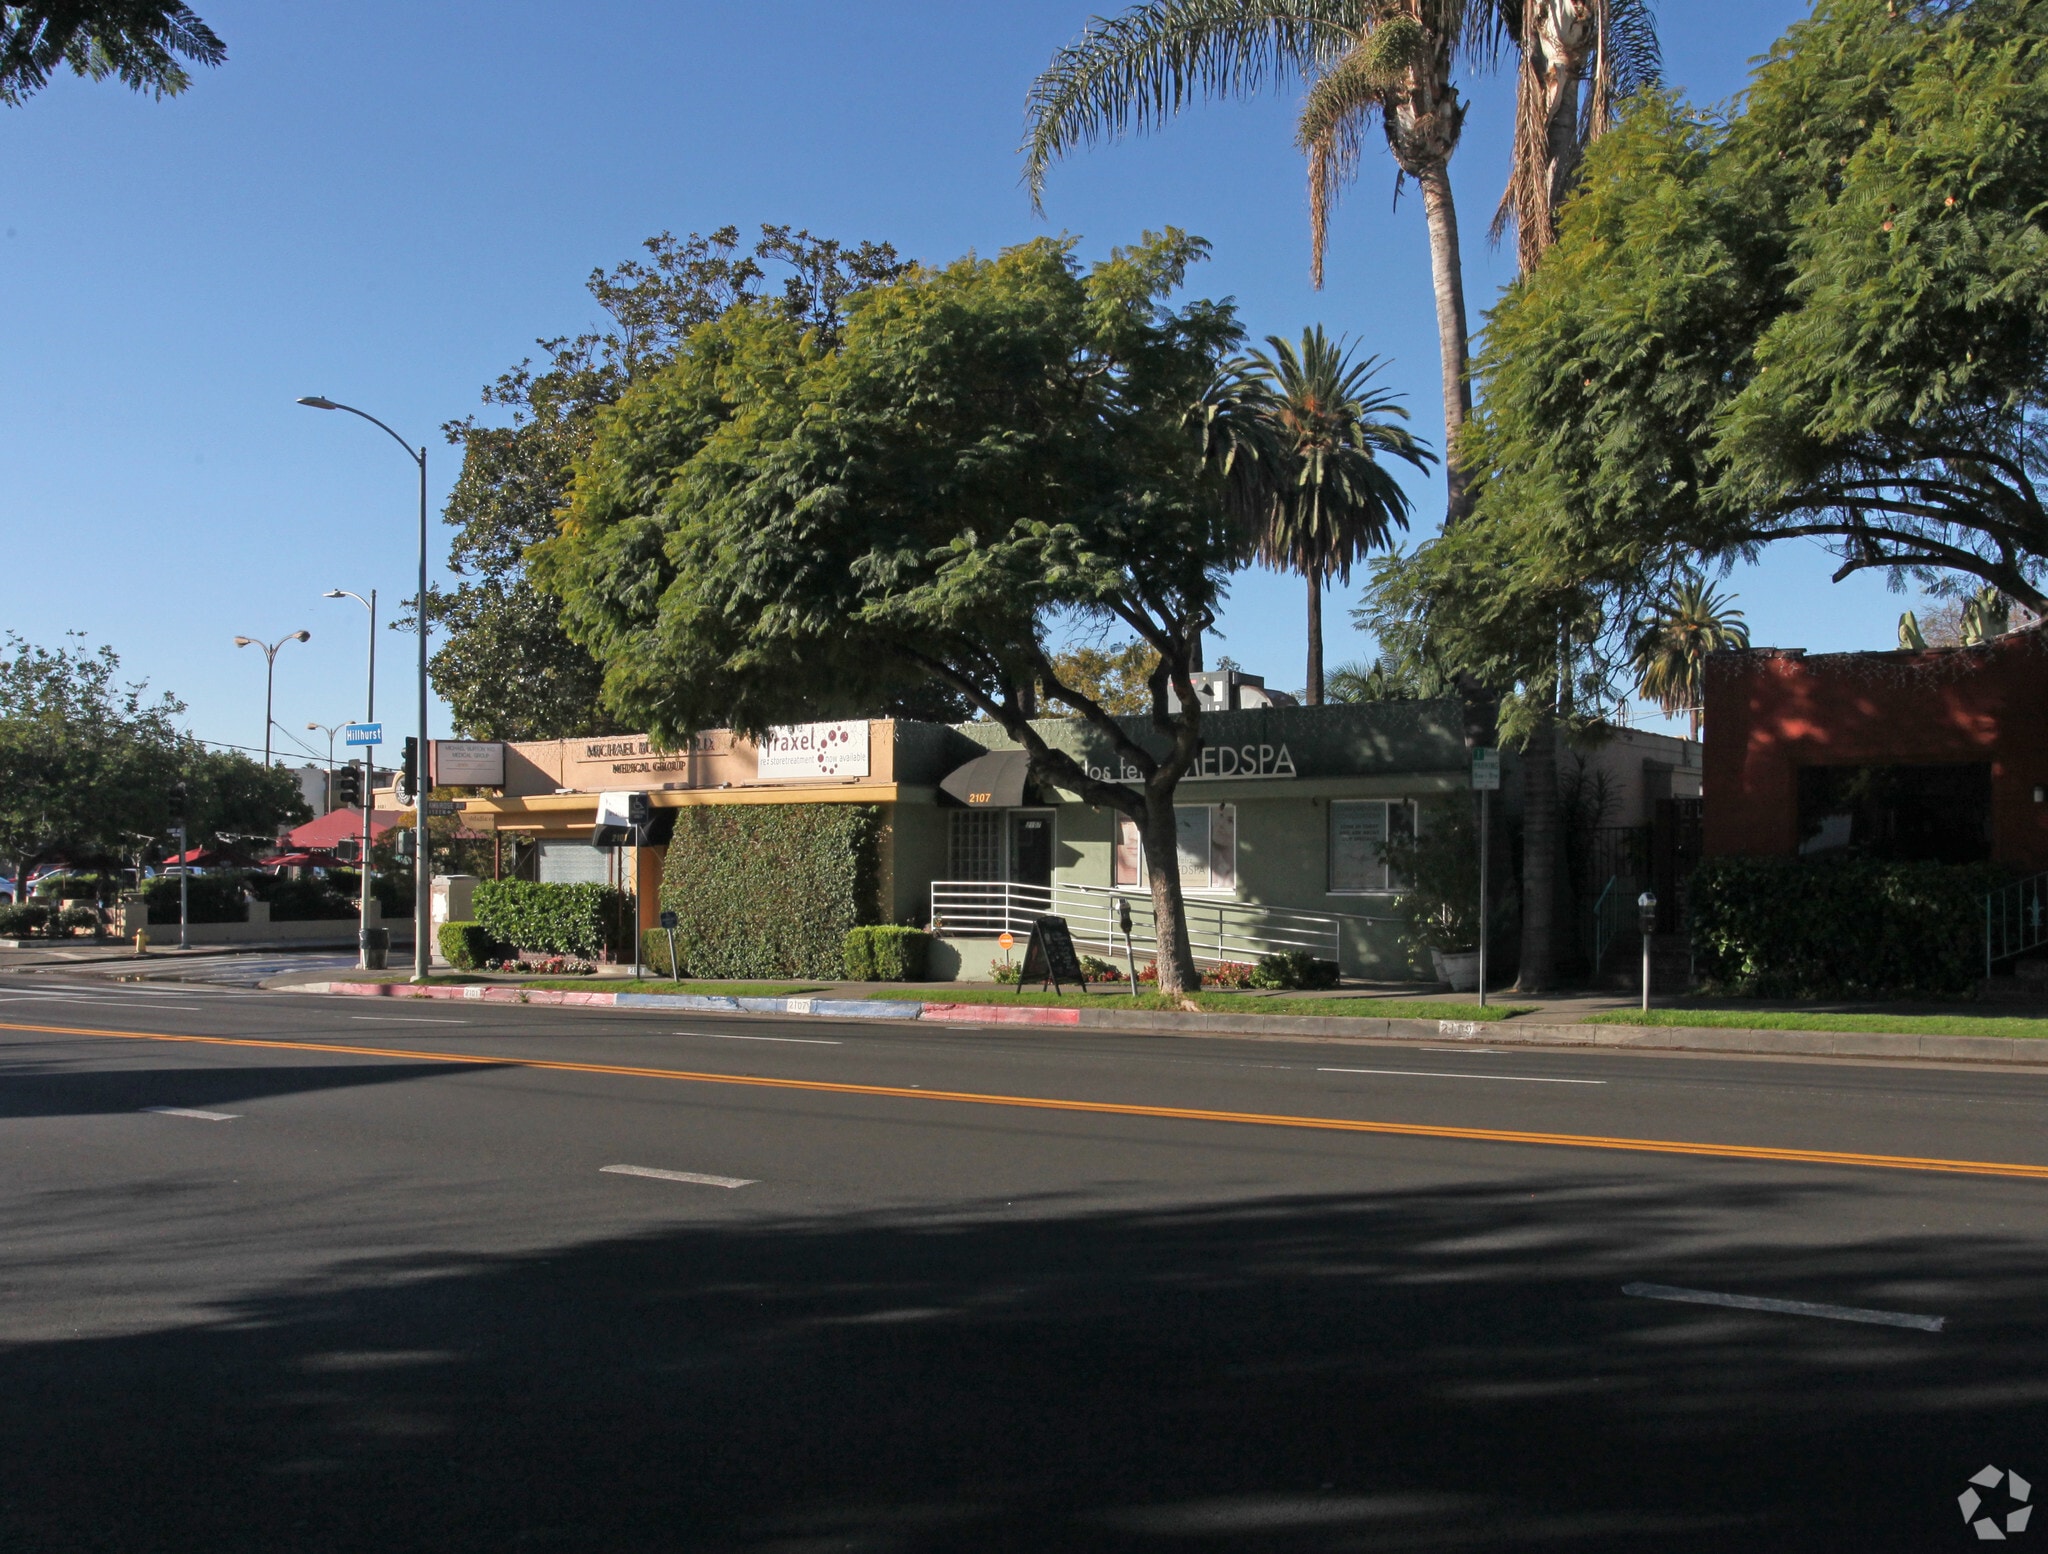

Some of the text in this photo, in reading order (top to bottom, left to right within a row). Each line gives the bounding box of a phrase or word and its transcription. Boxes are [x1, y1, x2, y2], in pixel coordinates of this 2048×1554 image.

[347, 728, 381, 741] Hillhurst
[587, 742, 637, 758] MICHAEL
[825, 756, 838, 764] now
[840, 753, 867, 763] available
[613, 761, 687, 774] MEDICAL GROUP
[969, 793, 992, 803] 2107
[790, 1000, 810, 1010] 2107
